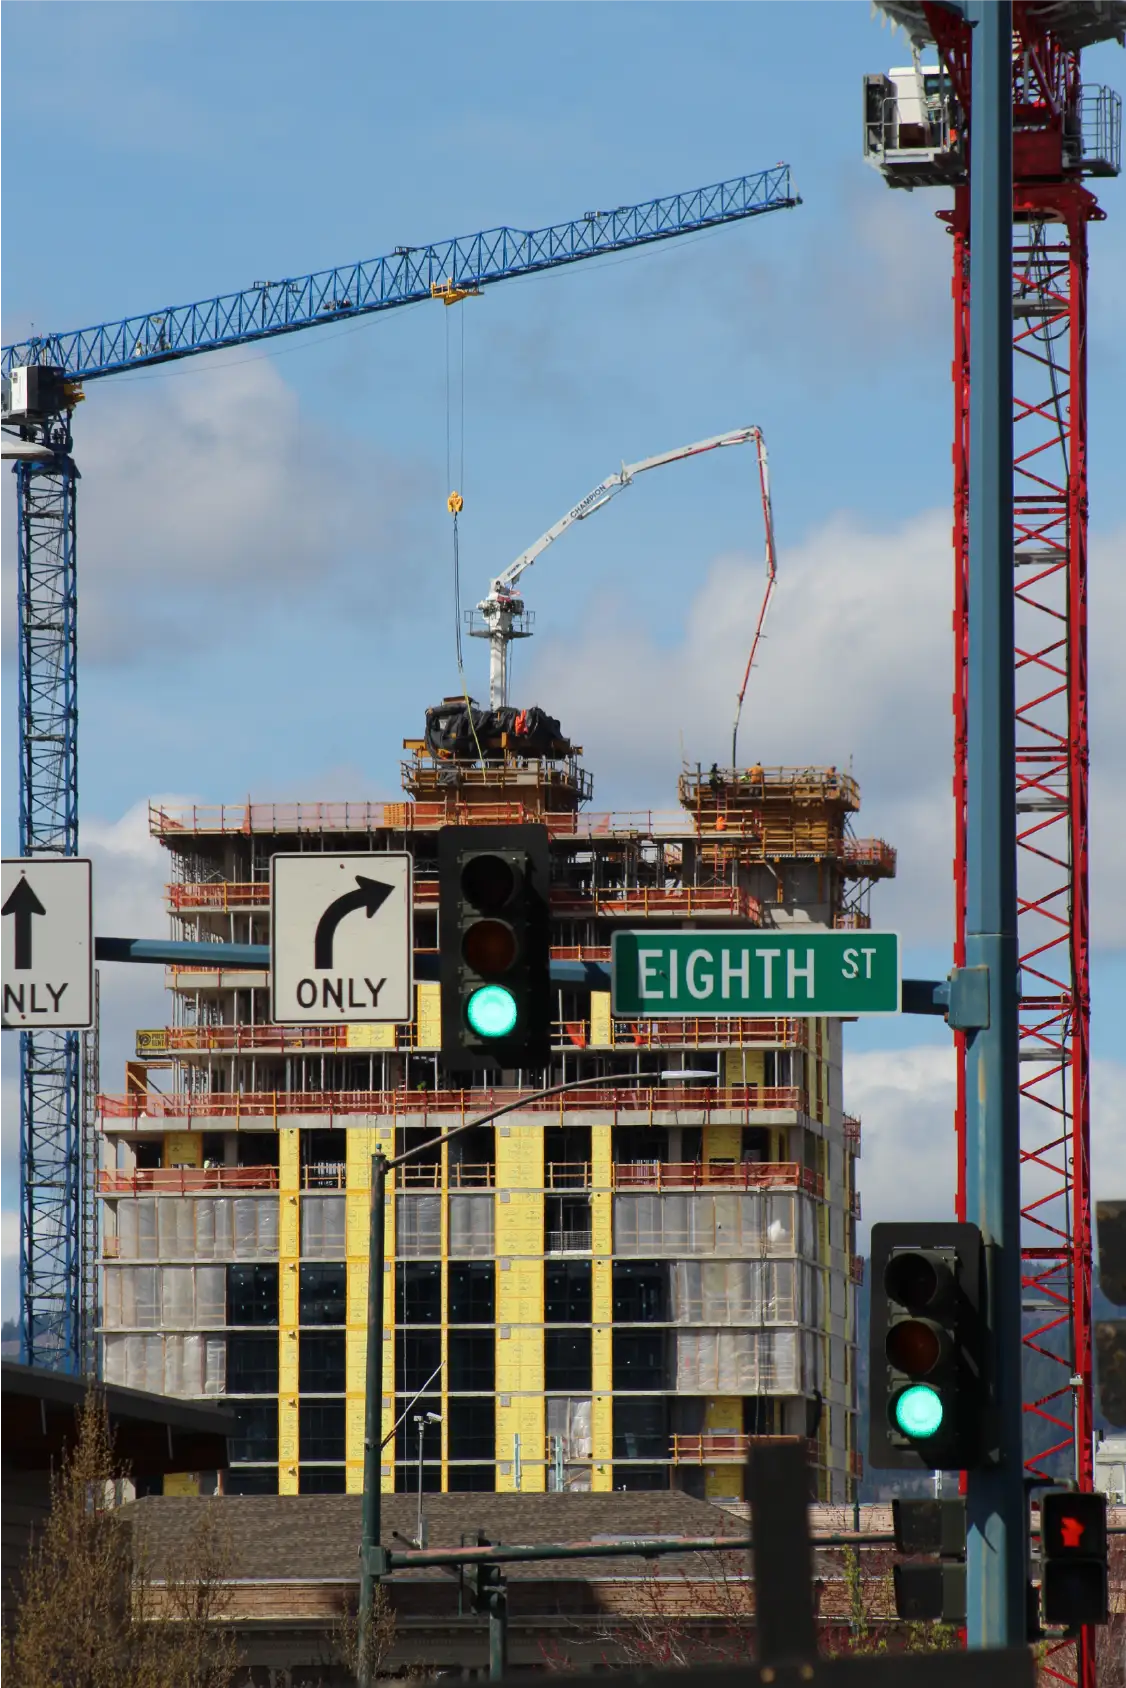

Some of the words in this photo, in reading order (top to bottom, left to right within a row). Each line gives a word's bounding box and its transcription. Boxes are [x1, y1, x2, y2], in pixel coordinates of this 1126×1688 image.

[570, 484, 606, 518] CHAMPION
[637, 948, 815, 1000] EIGHTH
[841, 947, 877, 979] ST
[3, 982, 69, 1013] NLY
[296, 977, 387, 1008] ONLY
